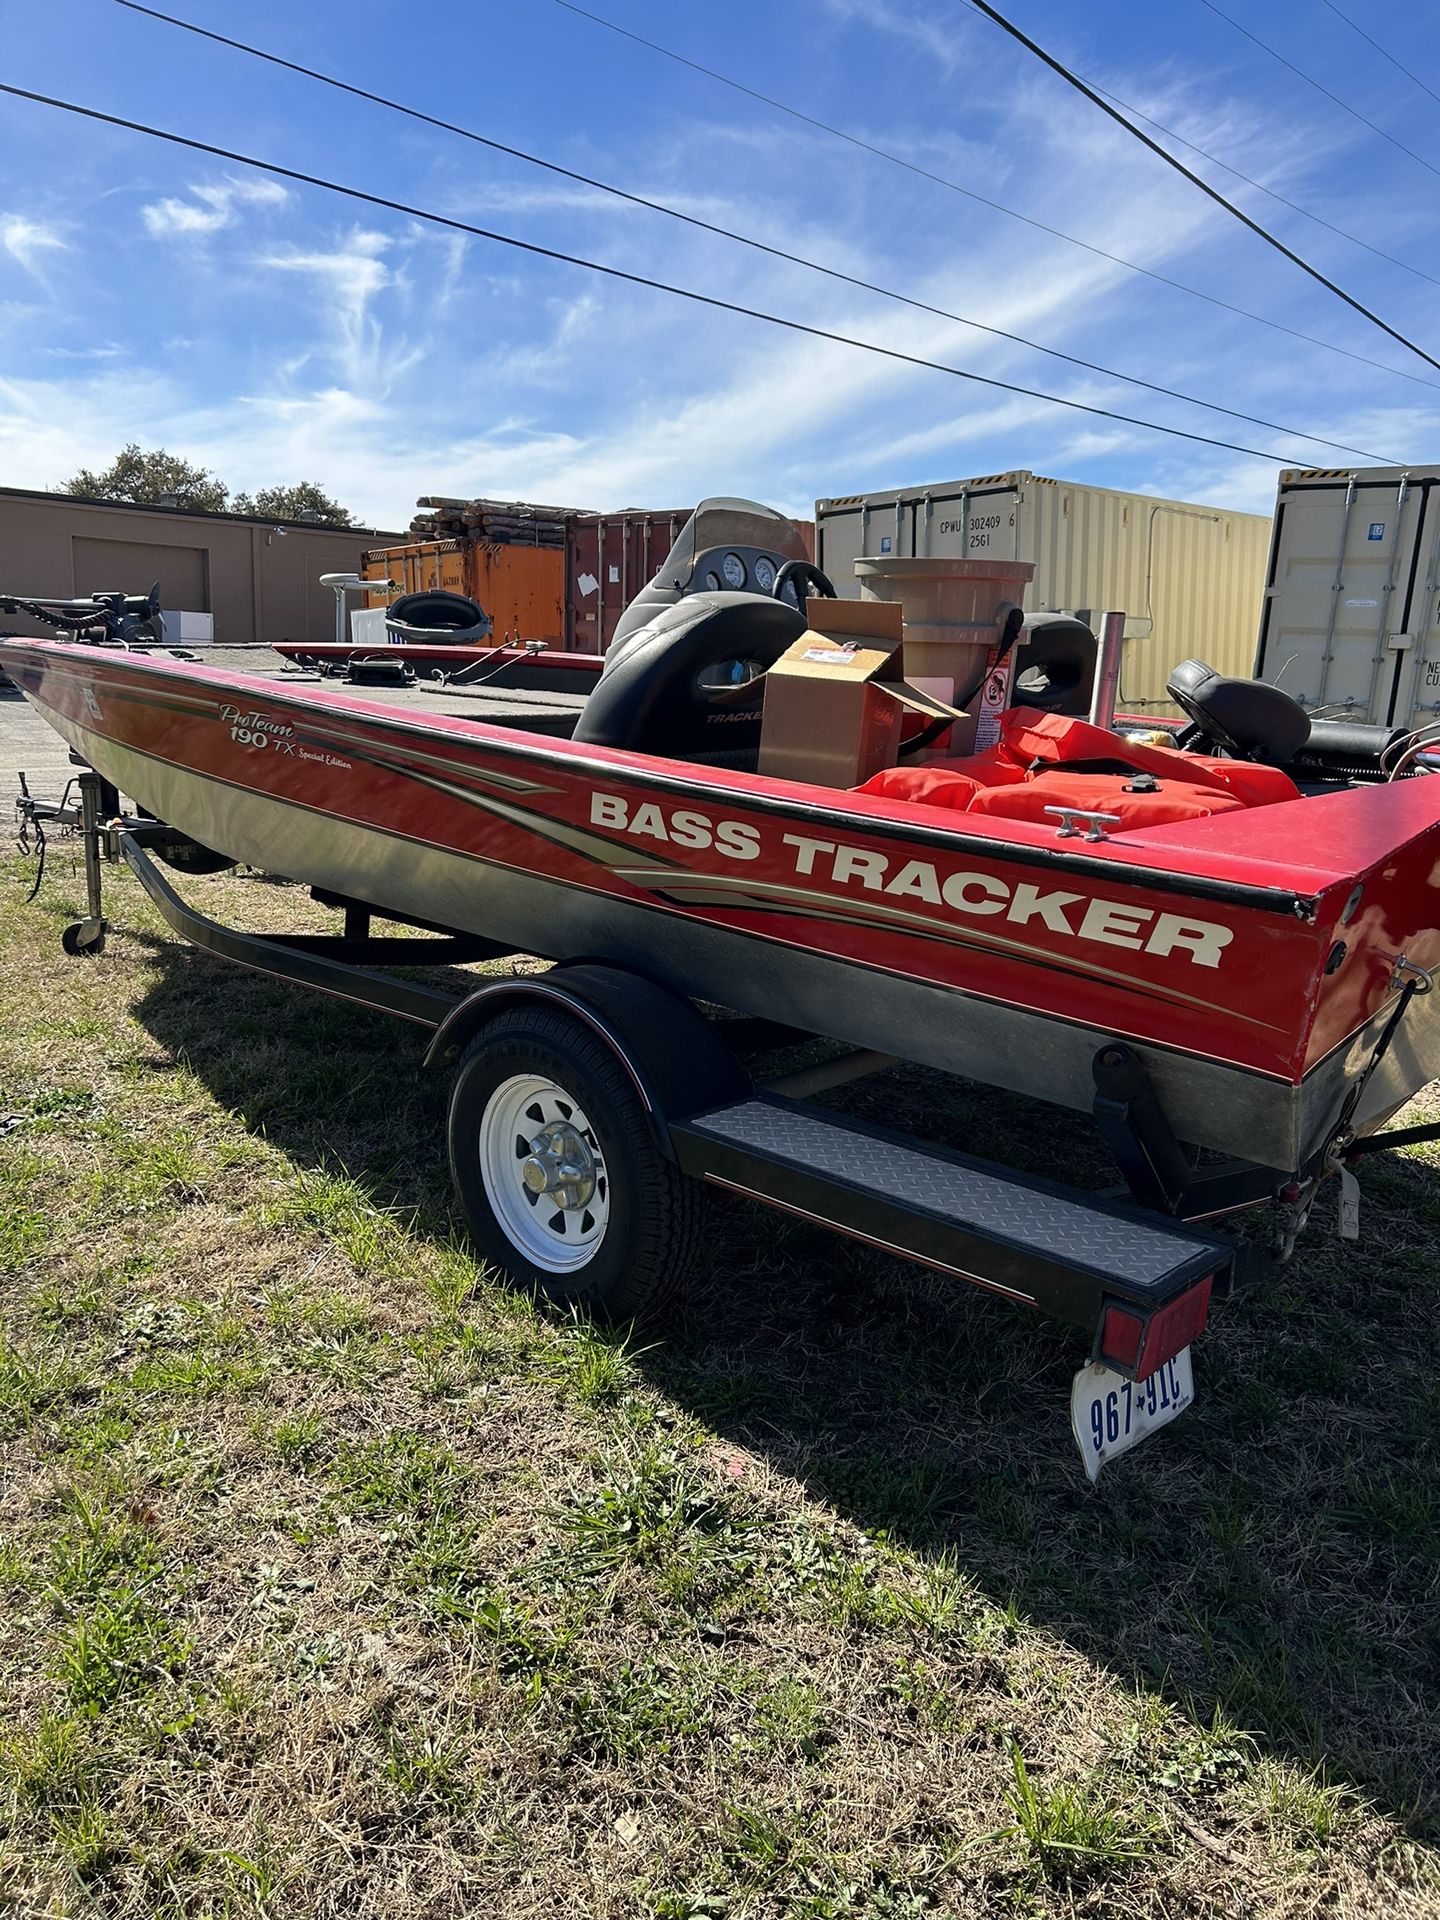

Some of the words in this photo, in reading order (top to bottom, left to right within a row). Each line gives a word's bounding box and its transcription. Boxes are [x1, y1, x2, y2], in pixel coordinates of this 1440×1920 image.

[970, 515, 1000, 531] 302409
[1009, 514, 1015, 527] 6
[970, 534, 990, 548] 25G1
[219, 703, 294, 738] ProTeam
[706, 710, 763, 724] TRACKE
[229, 726, 268, 748] 190
[272, 739, 297, 756] TX
[298, 747, 325, 762] Special
[325, 754, 352, 770] Edition
[590, 792, 761, 861] BASS
[782, 832, 1234, 968] TRACKER
[1090, 1381, 1132, 1451] 967
